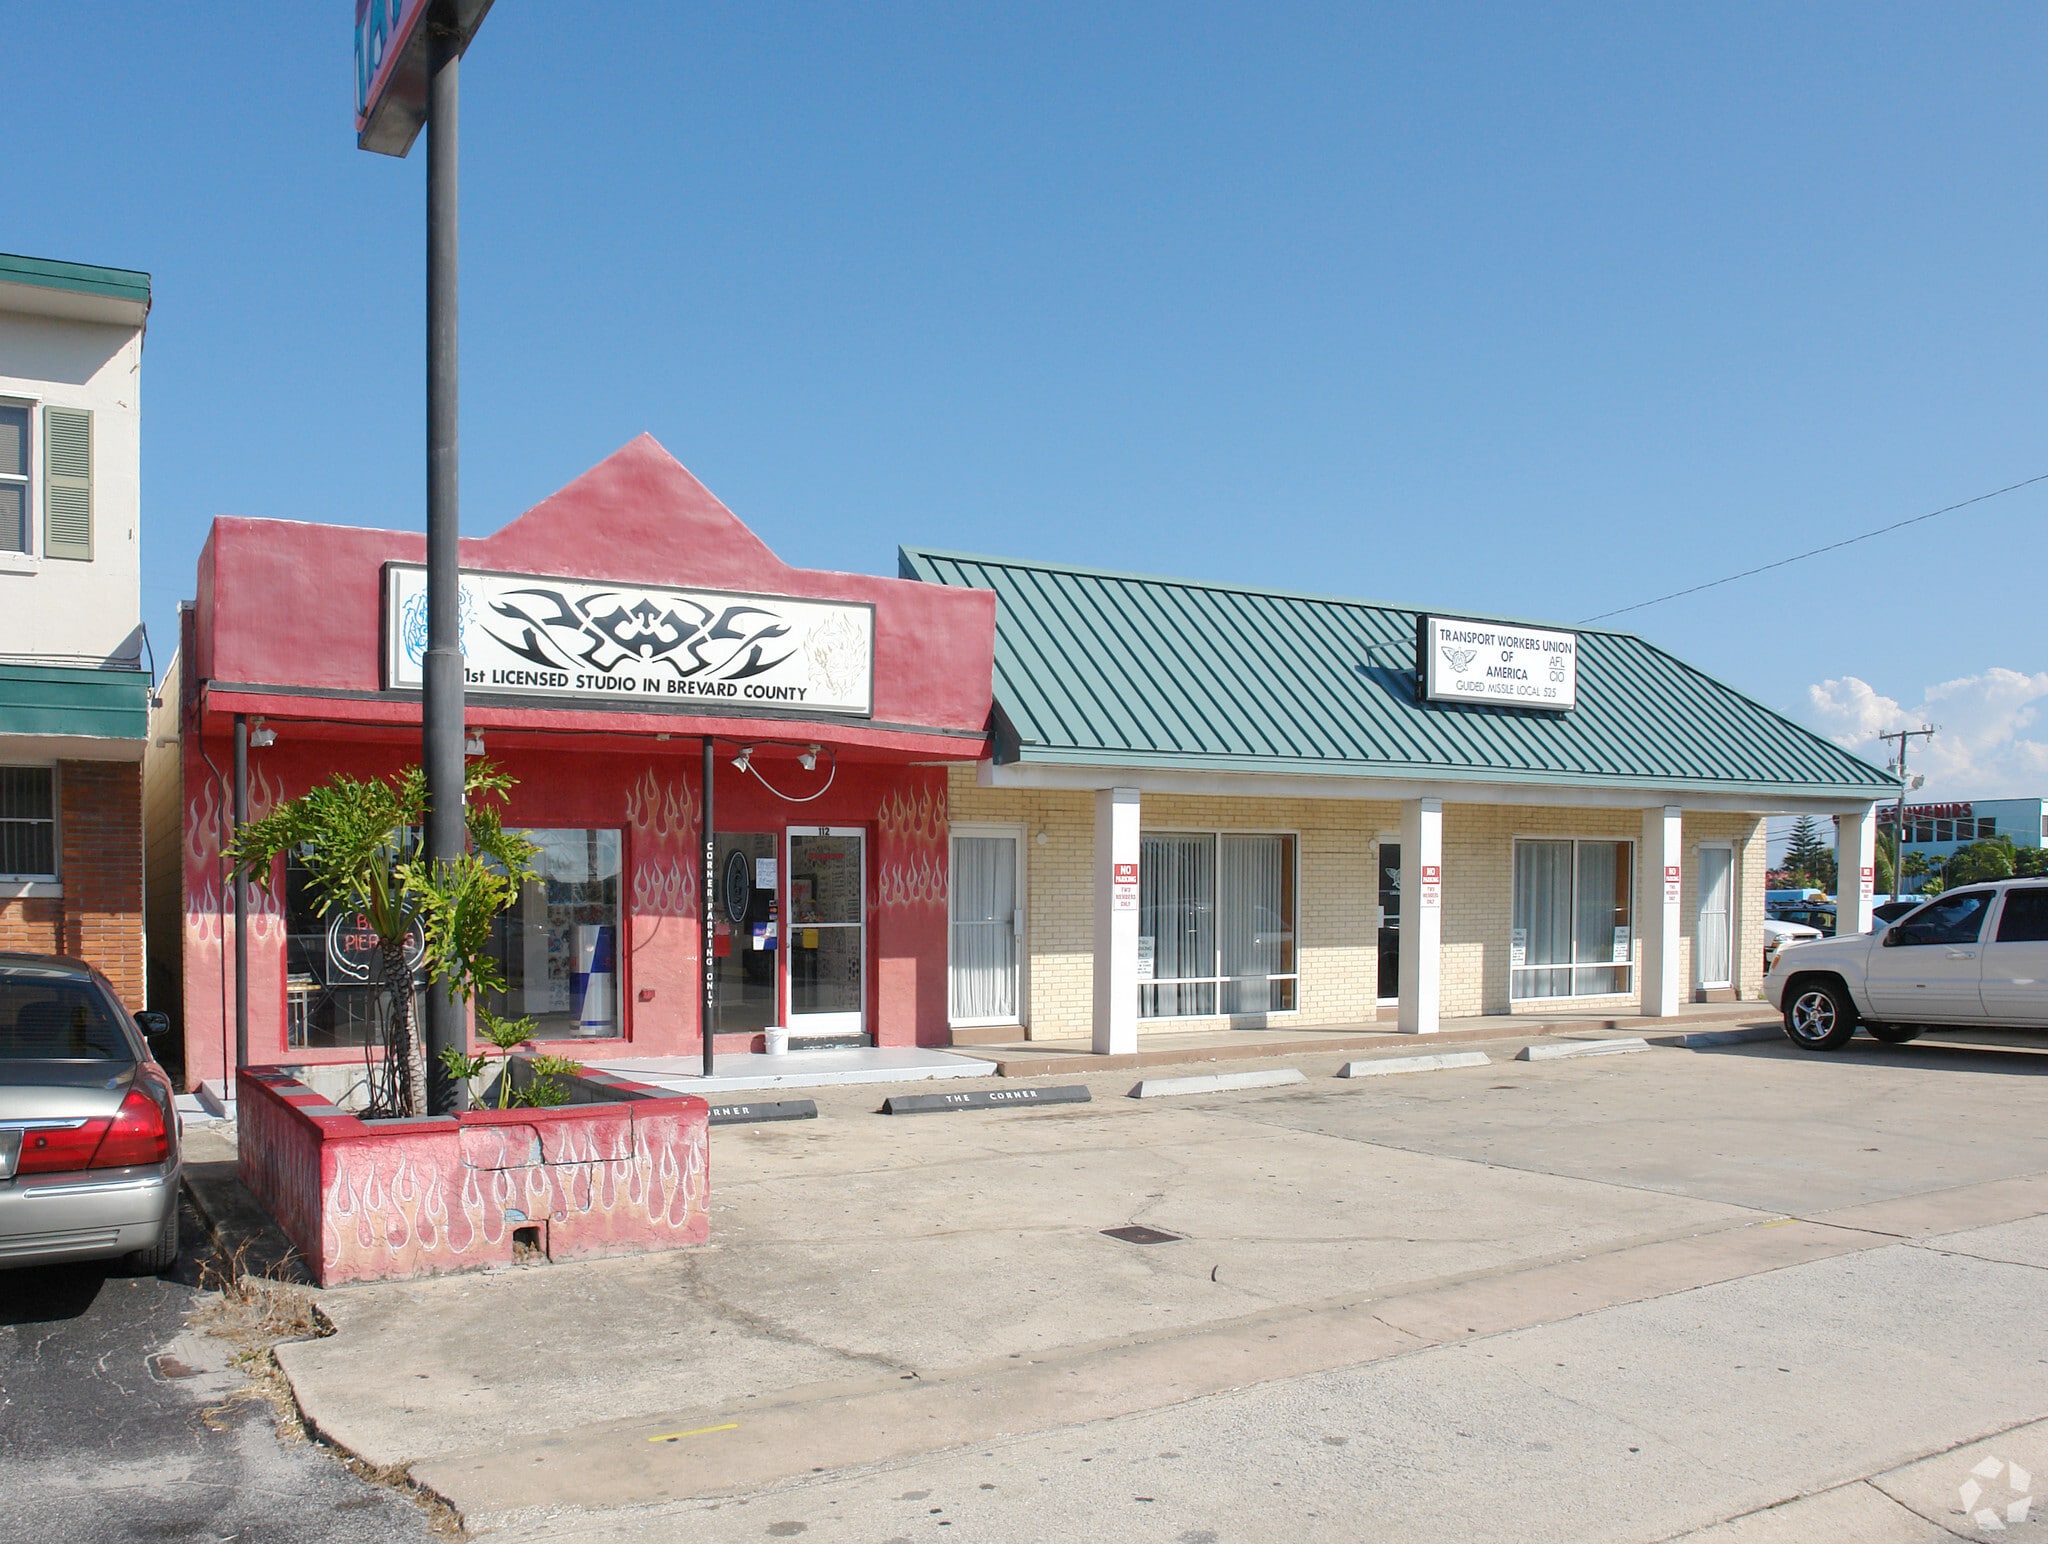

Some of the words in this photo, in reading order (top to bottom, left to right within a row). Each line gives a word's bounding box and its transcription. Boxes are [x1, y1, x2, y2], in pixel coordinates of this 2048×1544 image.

[1440, 629, 1495, 646] TRANSPORT
[1498, 635, 1540, 651] WORKERS
[1543, 641, 1572, 654] UNION
[1501, 651, 1513, 662] OF
[1549, 656, 1565, 668] AFL
[1486, 666, 1528, 680] AMERICA
[1549, 670, 1565, 683] CIO
[464, 668, 485, 683] 1st
[492, 669, 569, 687] LICENSED
[576, 675, 636, 691] STUDIO
[643, 678, 660, 692] IN
[667, 679, 737, 697] BREVARD
[744, 684, 808, 701] COUNTY
[1456, 680, 1485, 692] GUIDED
[1488, 683, 1514, 695] MISSILE
[1517, 685, 1540, 697] LOCAL
[1543, 688, 1557, 697] 525
[818, 828, 830, 836] 112
[1120, 865, 1132, 875] NO
[945, 1094, 970, 1103] THE
[989, 1090, 1037, 1100] CORNER
